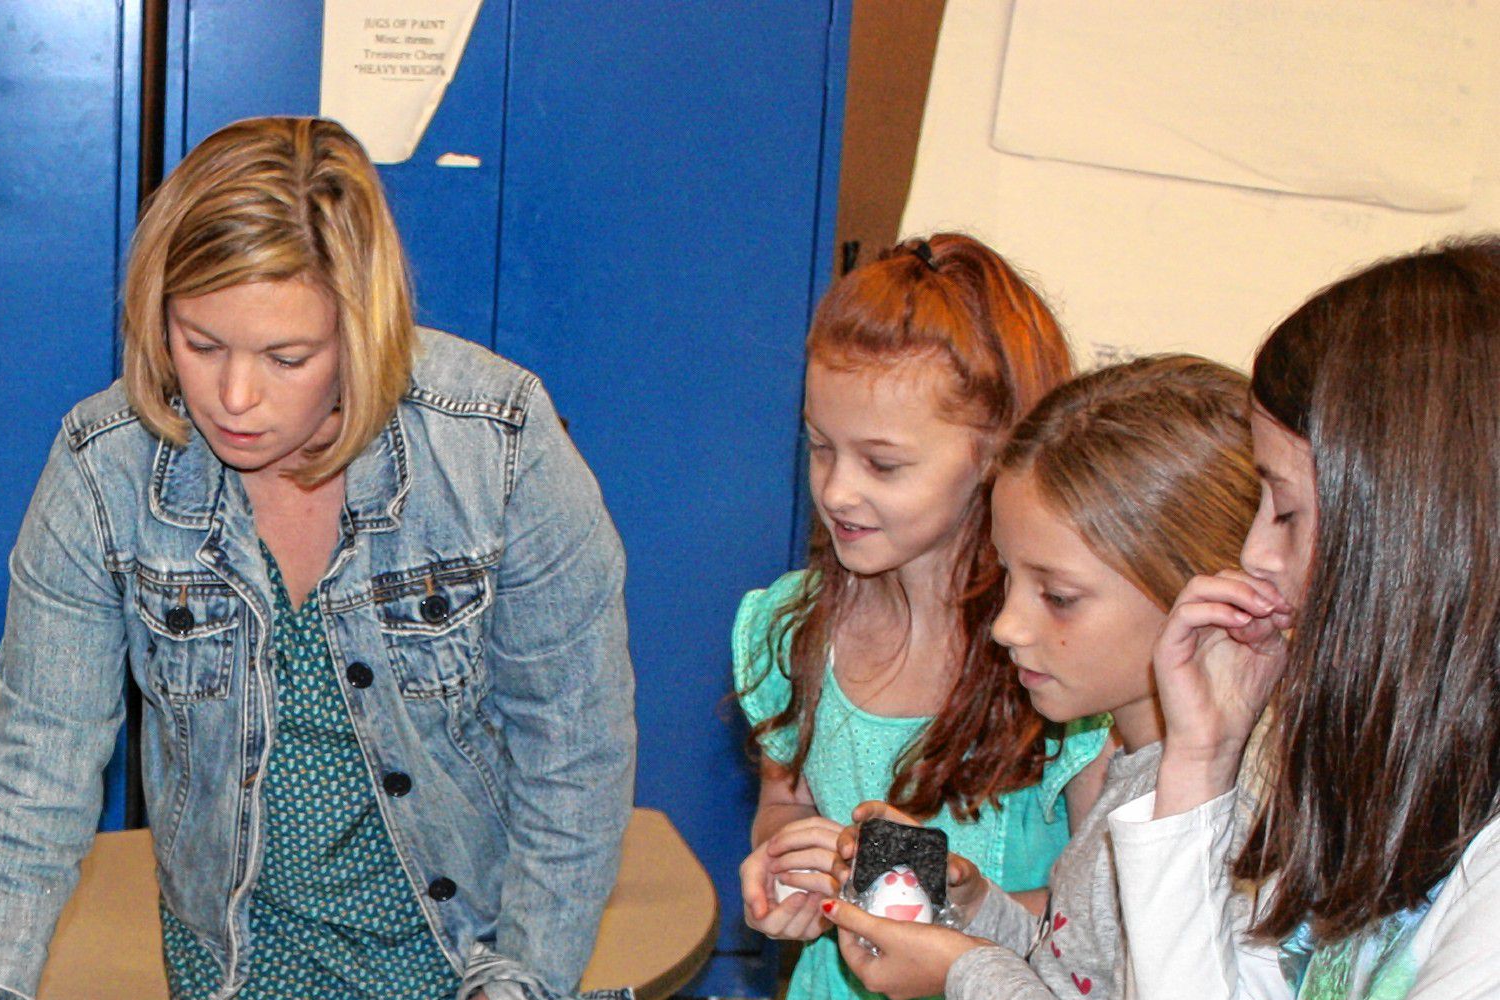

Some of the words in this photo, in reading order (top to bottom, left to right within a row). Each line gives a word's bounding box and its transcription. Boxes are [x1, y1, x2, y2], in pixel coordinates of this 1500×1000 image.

[392, 18, 407, 28] OF
[410, 19, 446, 29] PAINT
[363, 49, 412, 59] Treasure
